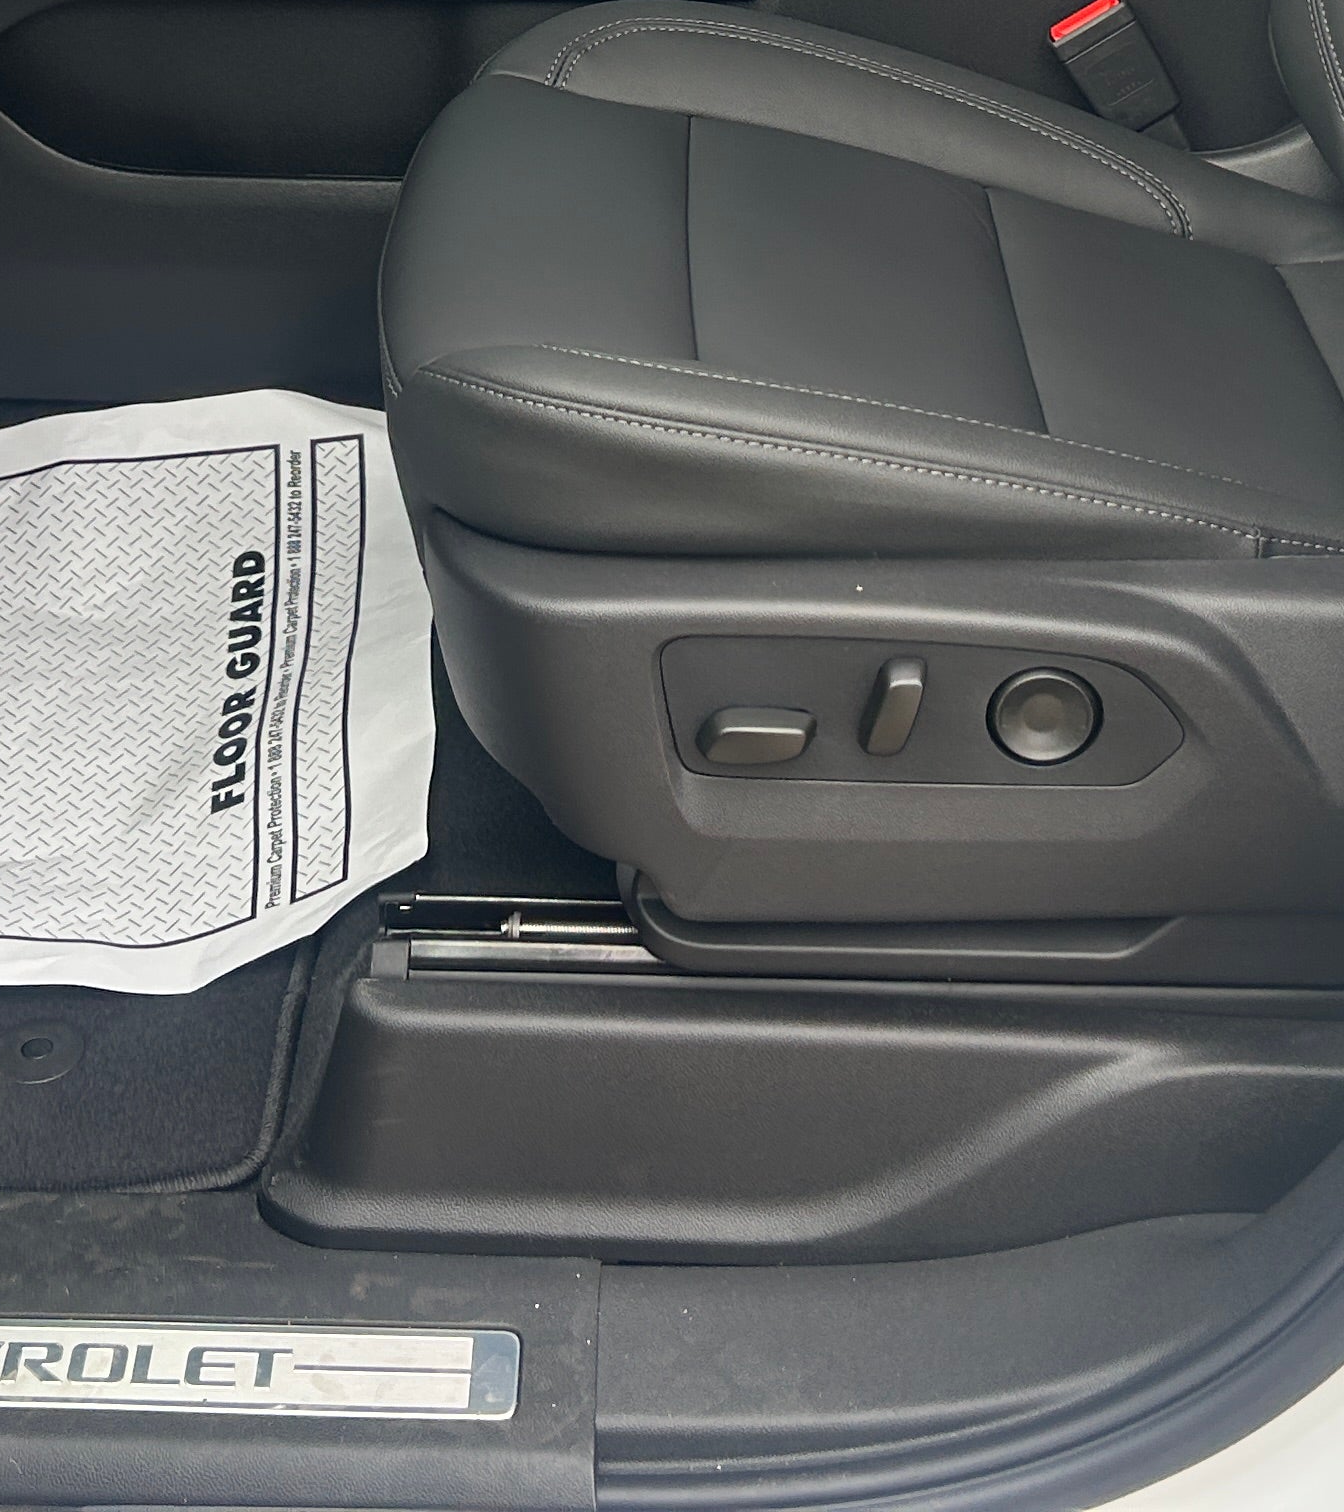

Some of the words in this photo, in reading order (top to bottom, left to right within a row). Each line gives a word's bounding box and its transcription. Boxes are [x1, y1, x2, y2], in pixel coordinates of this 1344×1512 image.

[286, 450, 302, 488] Reorder
[284, 568, 300, 606] Protection
[226, 550, 266, 680] GUARD
[283, 607, 302, 634] Carpet
[210, 688, 256, 815] FLOOR
[266, 776, 283, 828] Protection
[267, 830, 286, 863] Carpet
[264, 866, 283, 910] Premium
